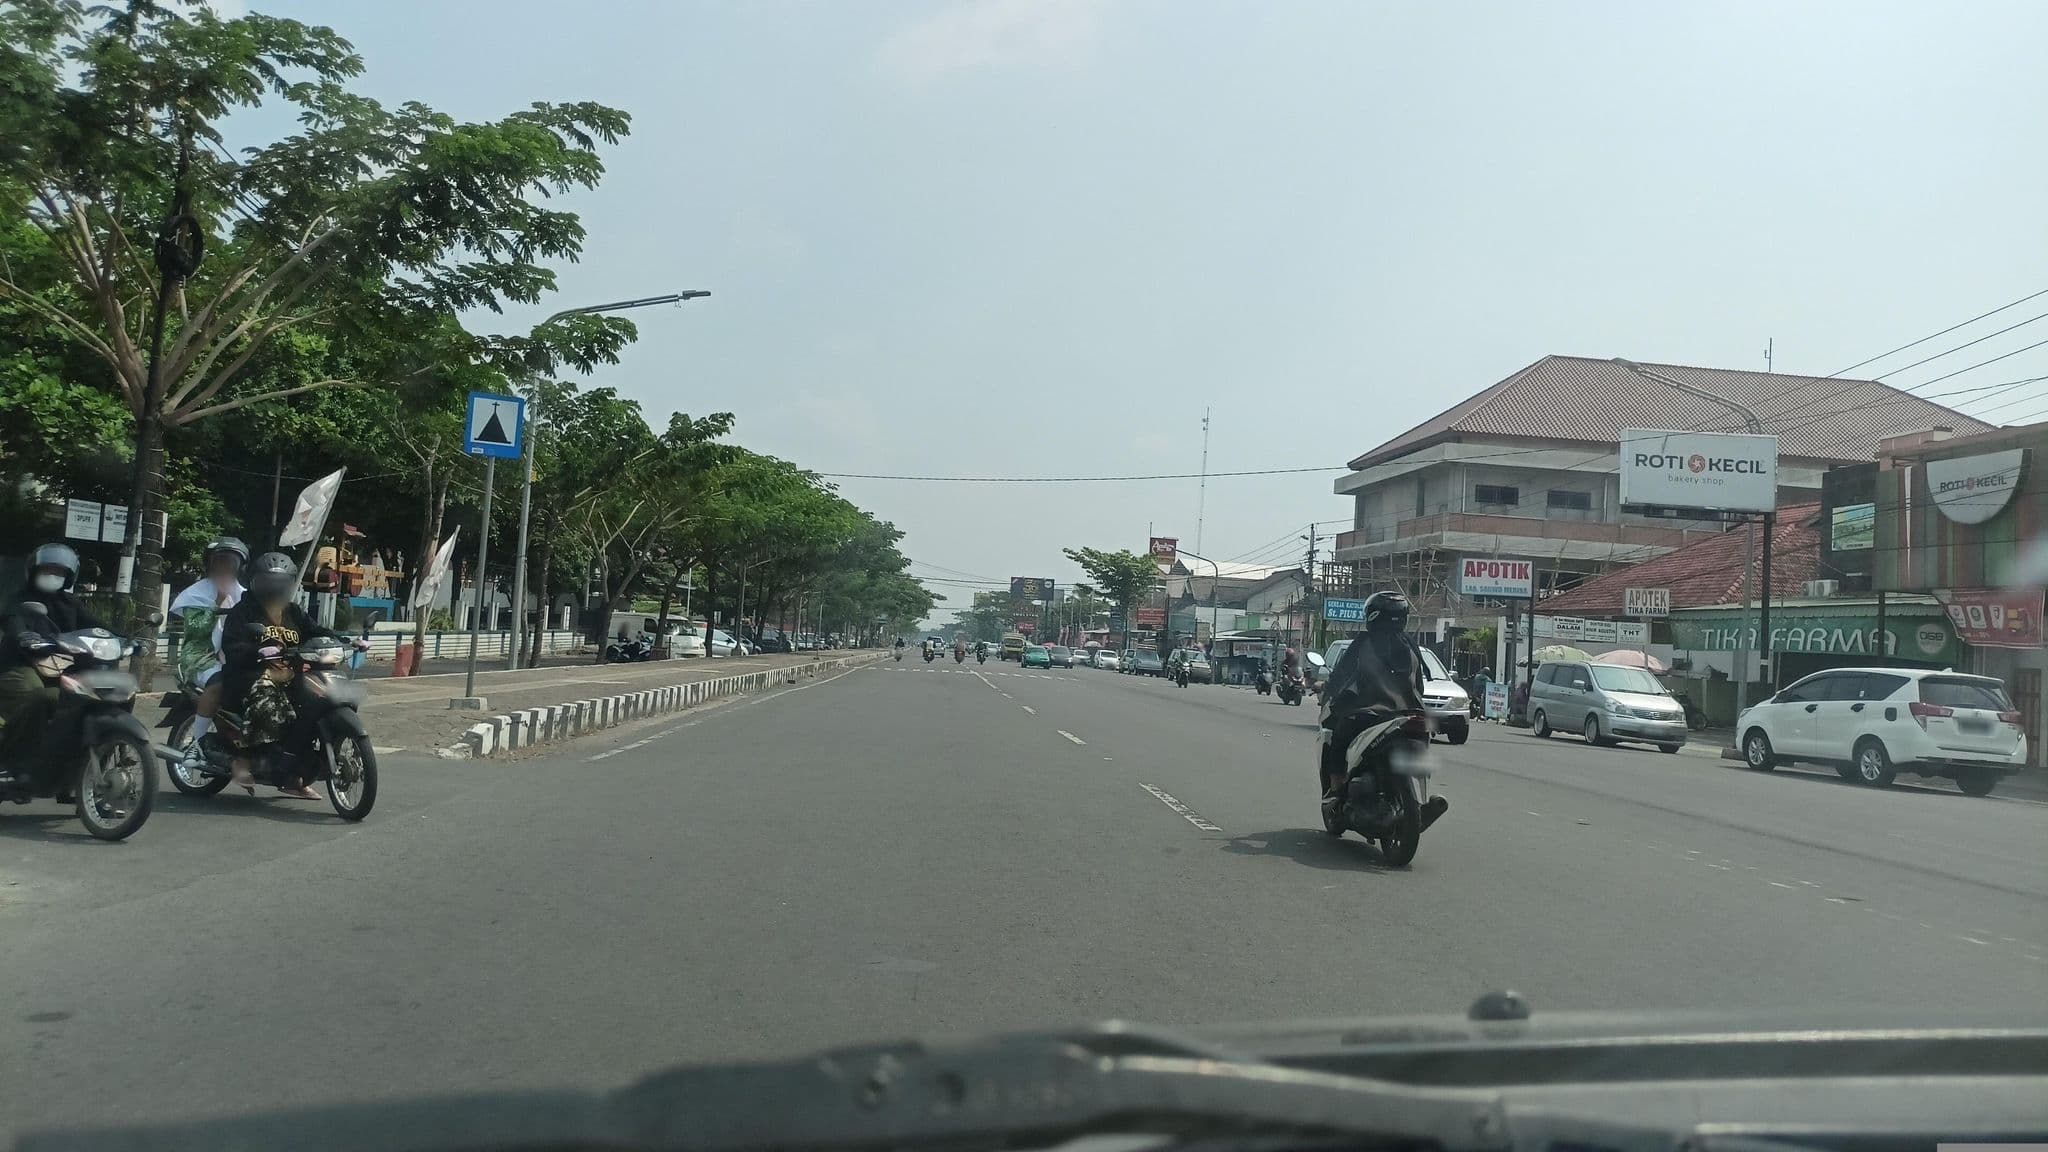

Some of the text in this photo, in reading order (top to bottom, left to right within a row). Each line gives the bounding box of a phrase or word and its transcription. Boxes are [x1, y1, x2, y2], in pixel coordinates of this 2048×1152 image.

[1635, 453, 1767, 474] ROTI KECIL
[1668, 473, 1724, 486] bakery shop
[1940, 475, 2007, 492] ROTI KECIL
[1464, 561, 1530, 580] APOTIK
[1628, 589, 1667, 607] APOTEK
[1339, 609, 1357, 618] PIUS
[1645, 607, 1667, 615] FARMA
[1701, 627, 1897, 656] TIKA FARMA
